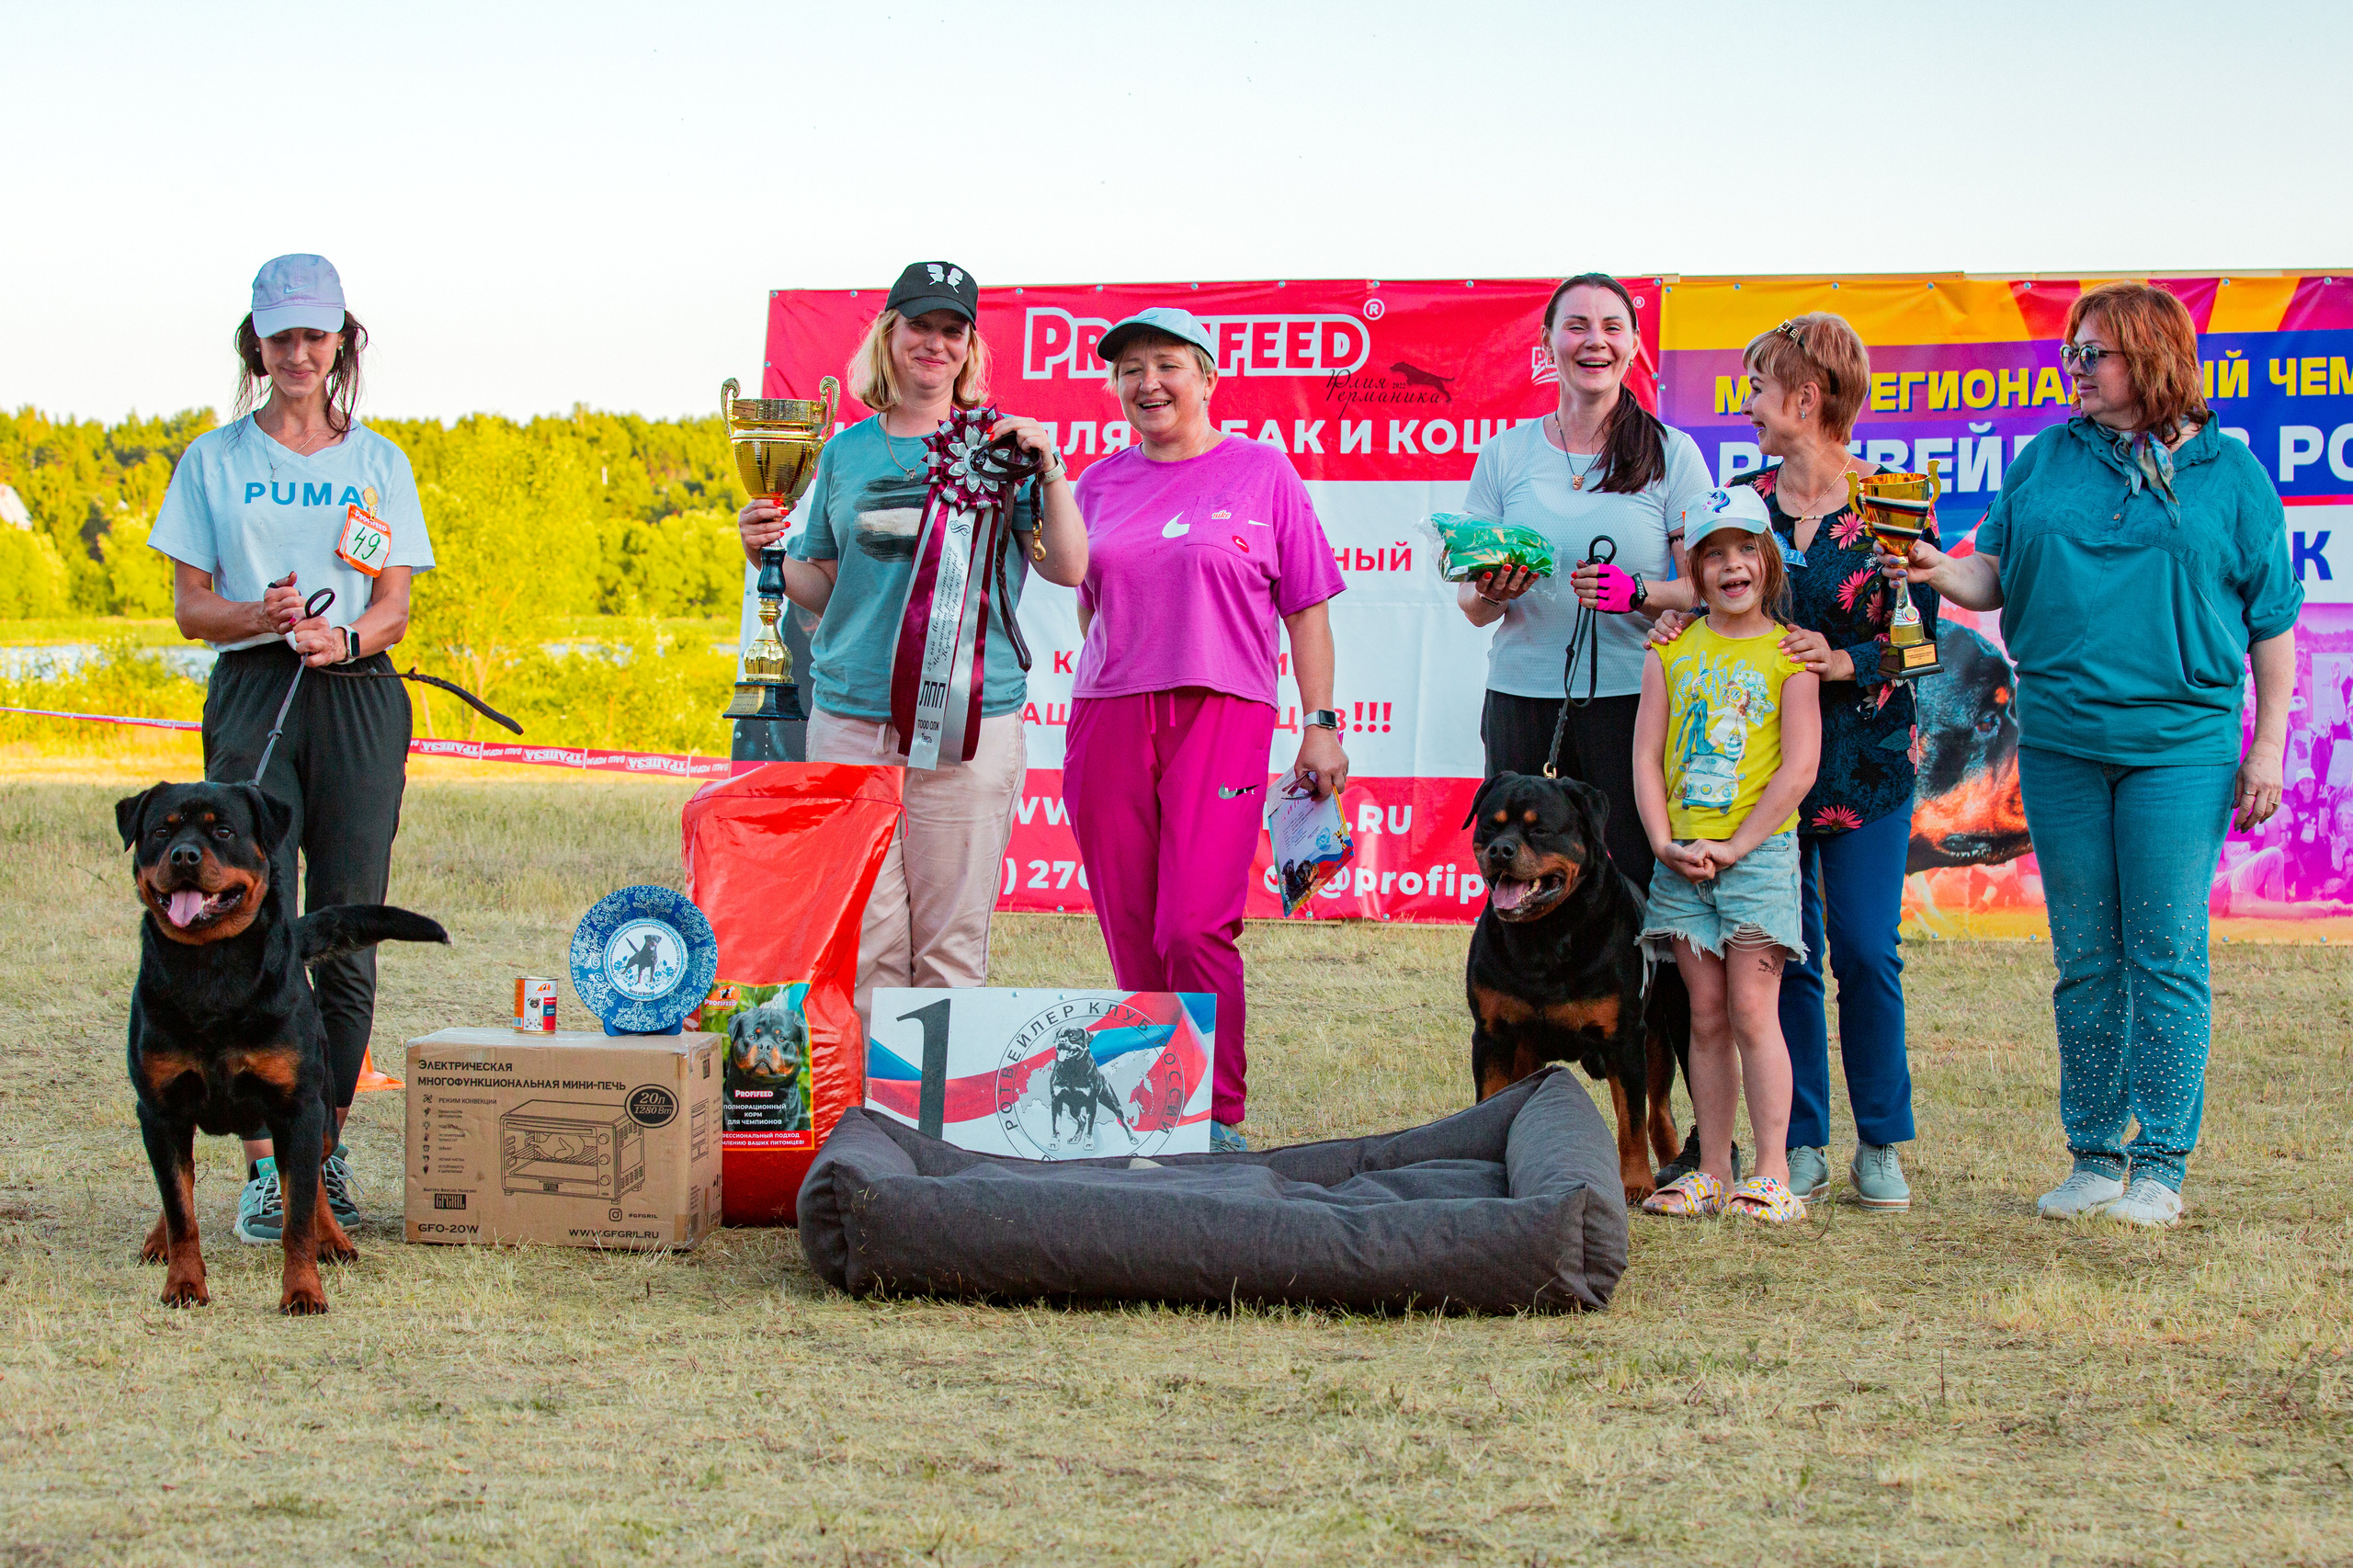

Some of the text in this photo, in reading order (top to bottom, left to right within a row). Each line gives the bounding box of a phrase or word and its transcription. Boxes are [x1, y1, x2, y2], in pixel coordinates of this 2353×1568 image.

[1023, 307, 1370, 380] PRFEED
[1340, 419, 1372, 454] И
[1389, 418, 1538, 454] КОШ
[244, 482, 364, 509] PUMA
[1211, 510, 1232, 519] nike
[353, 527, 381, 560] 49
[919, 680, 947, 709] ЛПП
[420, 741, 480, 757] ТРАПЕЗА
[483, 747, 522, 757] ВАШ КОРМ
[525, 749, 584, 766] ТРАПЕЗА
[586, 755, 626, 766] ВАШ КОРМ
[627, 756, 688, 774] ТРАПЕЗА
[690, 762, 729, 774] ВАШ КОРМ
[1224, 787, 1255, 795] NIKE
[418, 1060, 513, 1072] ЭЛЕКТРИЧЕСКАЯ
[896, 998, 950, 1140] 1
[998, 1001, 1182, 1136] РОТВЕЙЛЕР КЛУБ РОССИИ
[417, 1076, 627, 1091] МНОГОФУНКЦИОНАЛЬНАЯ МИНИ-ПЕЧЬ
[634, 1106, 657, 1115] 1280
[418, 1223, 479, 1233] GFO-20W
[569, 1229, 659, 1238] WWW.GFGRIL.RU
